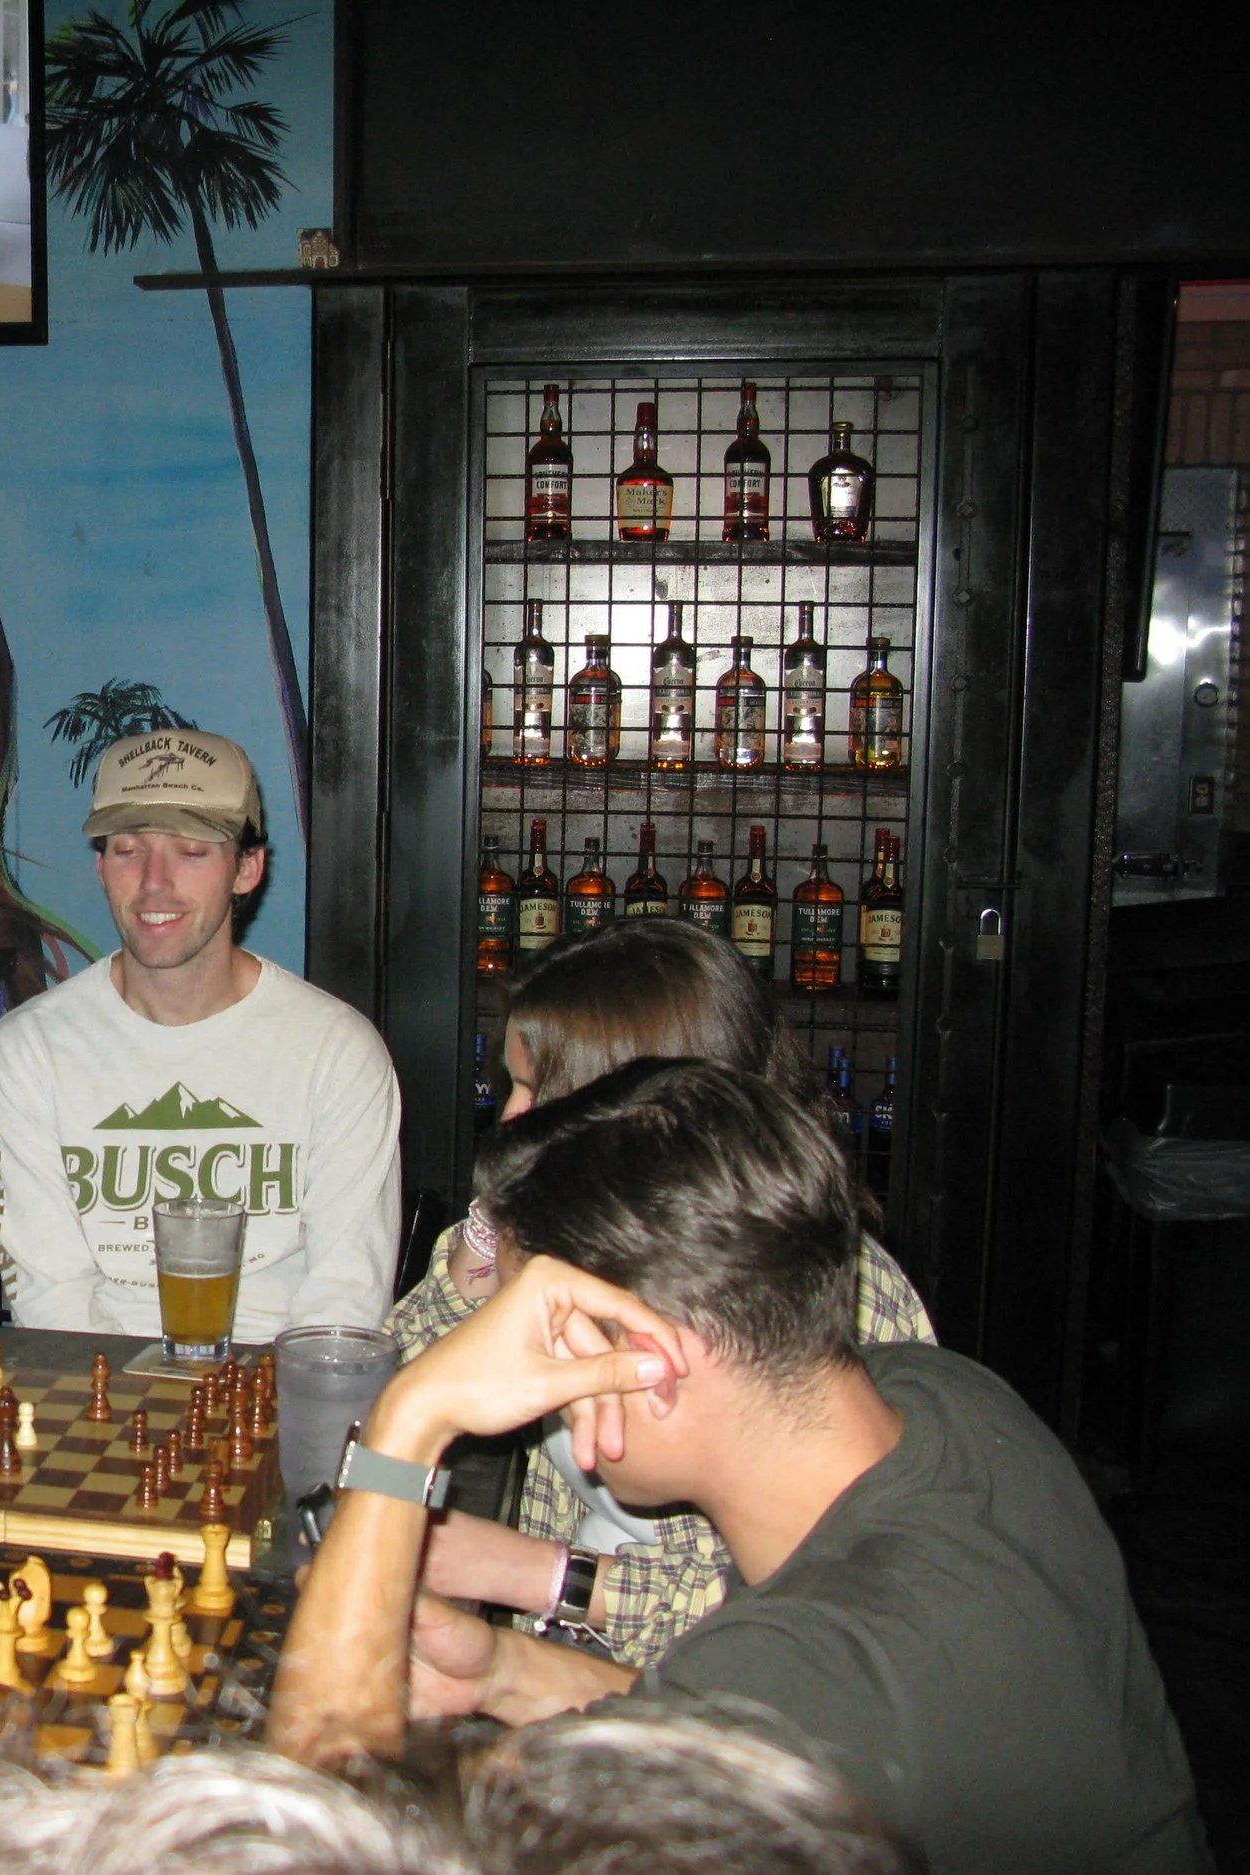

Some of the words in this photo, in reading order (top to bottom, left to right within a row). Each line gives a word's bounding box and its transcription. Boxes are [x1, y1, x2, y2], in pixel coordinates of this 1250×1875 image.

[118, 737, 172, 768] SHELLBACK
[178, 739, 219, 767] TAVERN
[162, 782, 189, 790] Beach
[60, 1143, 300, 1215] BUSCH
[98, 1243, 150, 1253] BREWED
